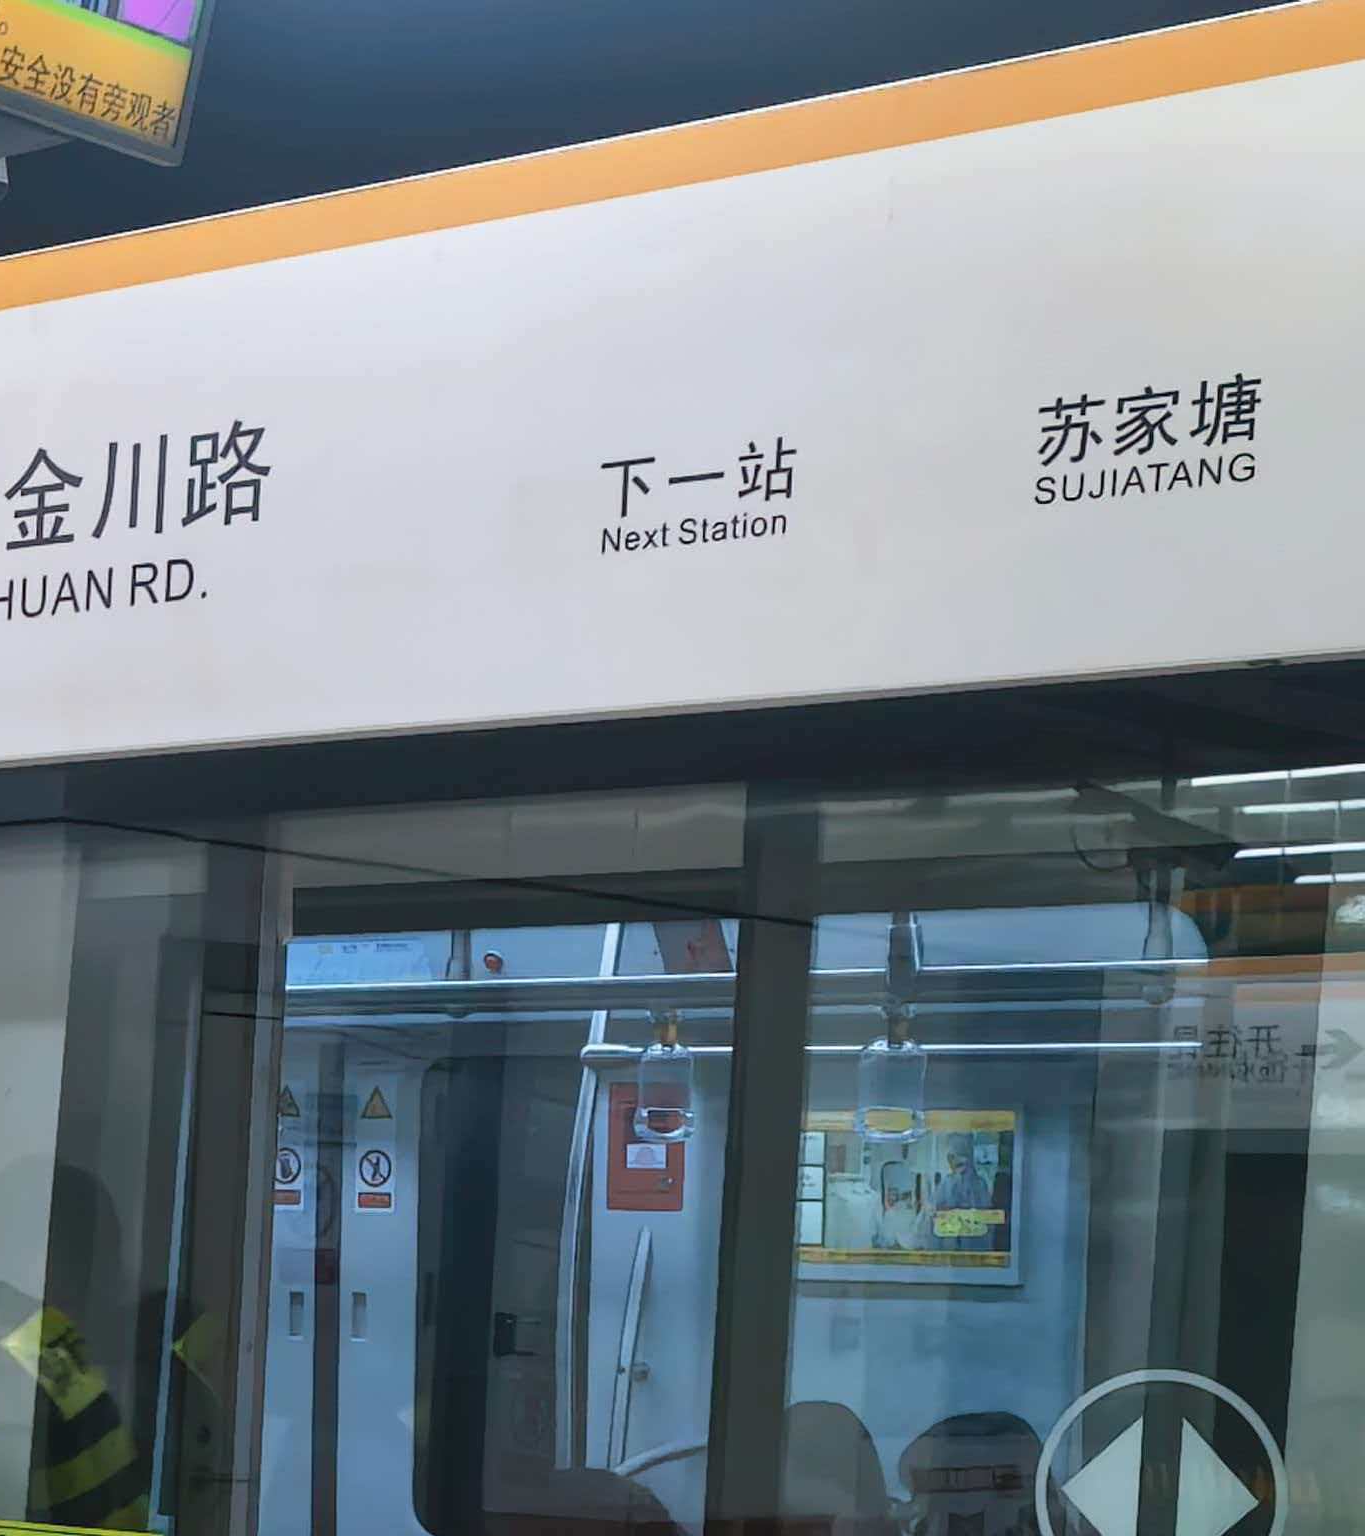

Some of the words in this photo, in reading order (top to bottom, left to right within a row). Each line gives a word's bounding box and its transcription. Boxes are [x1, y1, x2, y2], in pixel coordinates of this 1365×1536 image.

[1036, 372, 1263, 467] 苏家塘
[600, 436, 798, 518] 下一站
[1034, 453, 1258, 505] SUJIATANG
[600, 521, 670, 554] Next
[678, 512, 788, 546] Station
[129, 558, 209, 607] RD.
